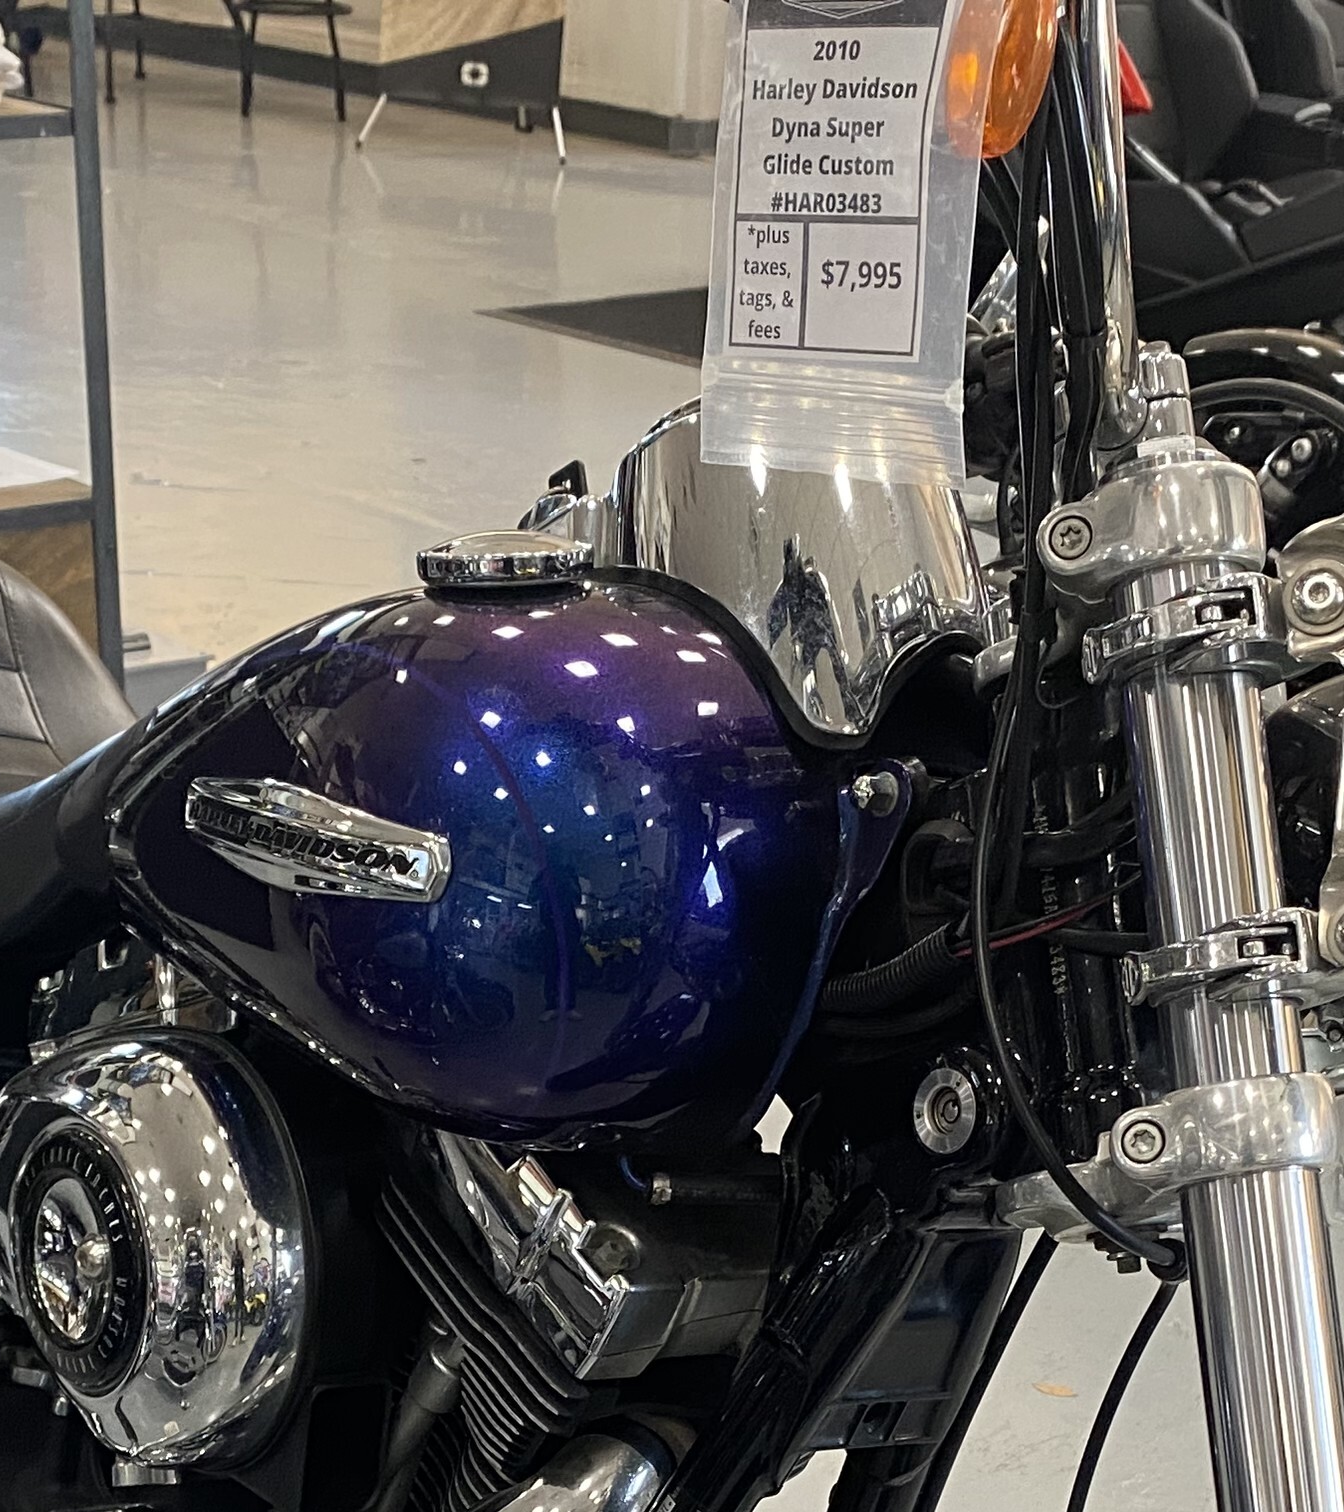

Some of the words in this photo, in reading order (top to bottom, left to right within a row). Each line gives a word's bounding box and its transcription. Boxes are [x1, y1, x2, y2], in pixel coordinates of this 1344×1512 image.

[813, 40, 861, 61] 2010
[752, 80, 817, 104] Harley
[823, 77, 918, 100] Davidson
[771, 117, 821, 143] Dyna
[826, 118, 885, 143] Super
[763, 155, 813, 176] Glide
[818, 155, 895, 176] Custom
[771, 192, 883, 214] #HAR03483
[743, 258, 791, 279] taxes,
[821, 260, 903, 292] $7,995
[739, 291, 777, 311] tags,
[782, 291, 794, 309] &
[748, 320, 781, 340] fees
